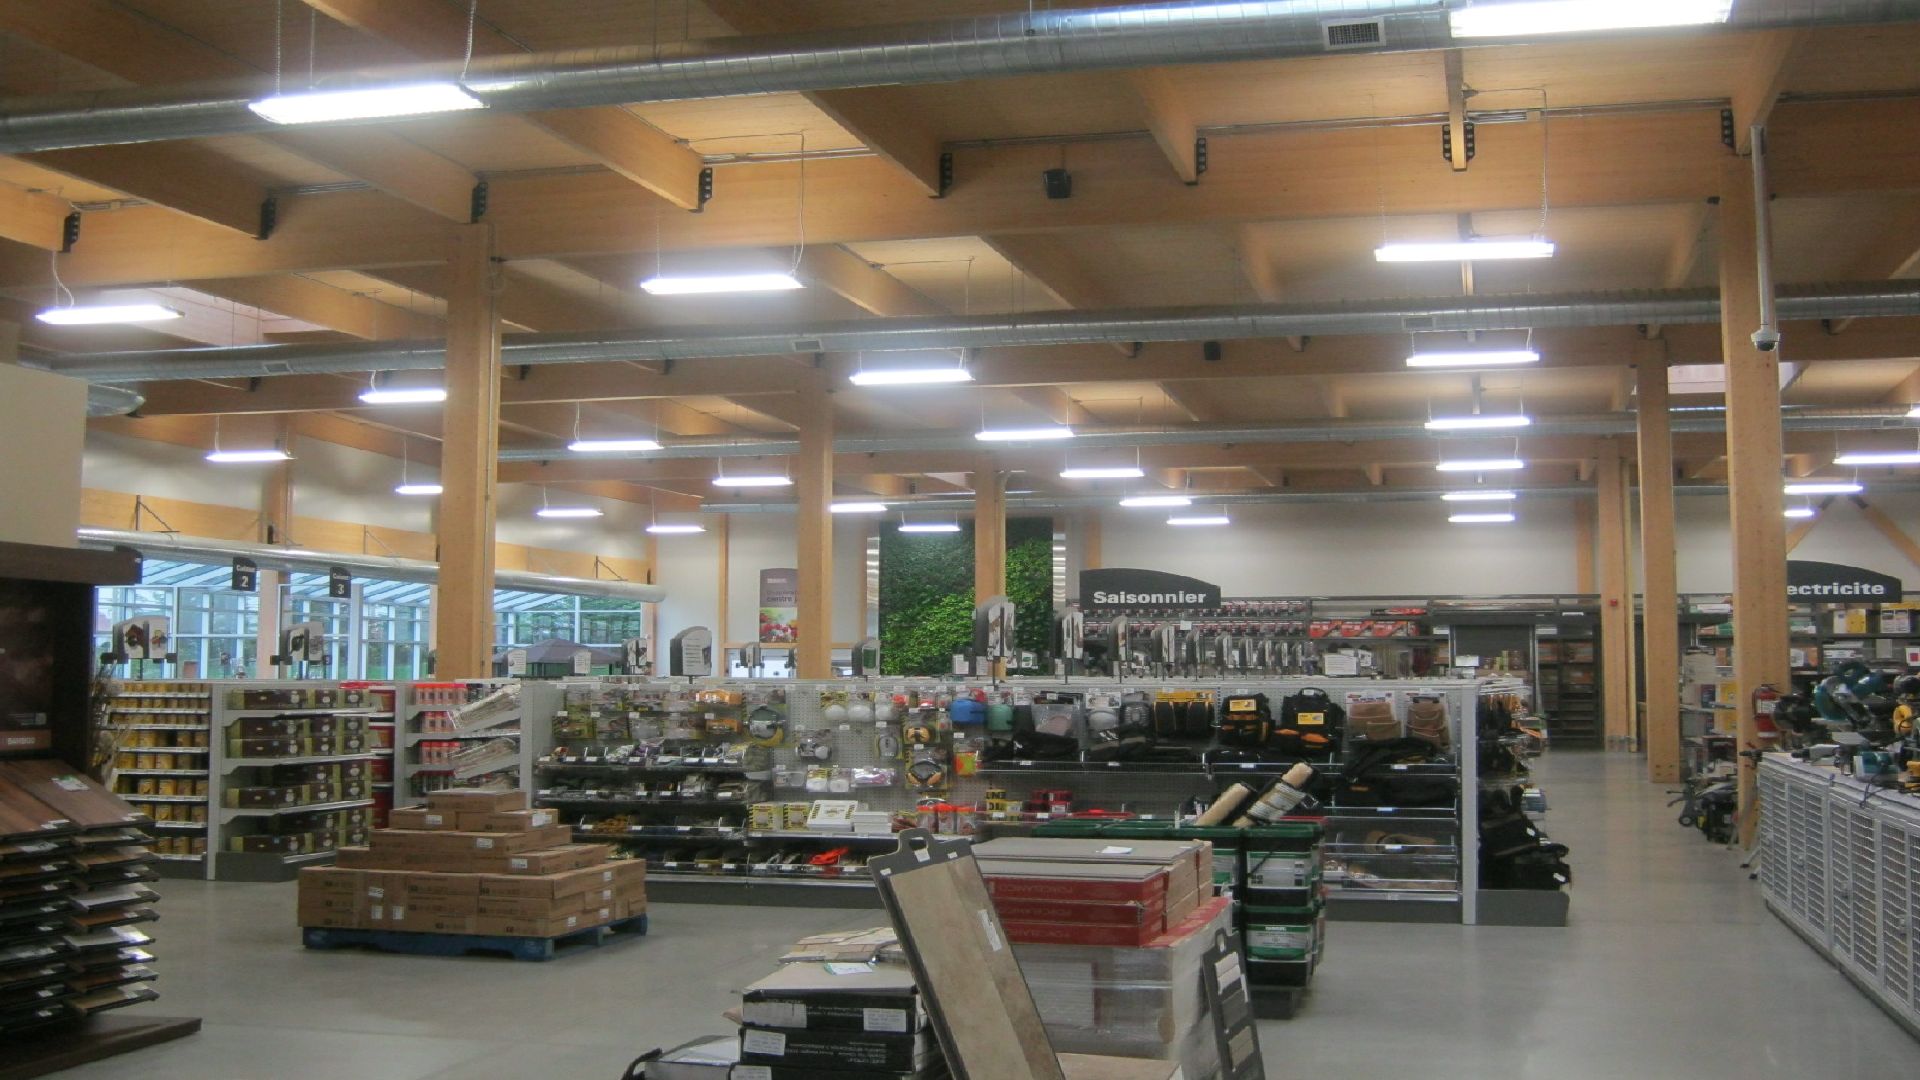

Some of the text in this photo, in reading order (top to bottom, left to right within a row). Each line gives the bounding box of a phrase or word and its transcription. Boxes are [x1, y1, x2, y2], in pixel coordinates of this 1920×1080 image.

[241, 576, 248, 588] 2
[337, 584, 344, 595] 3
[1094, 591, 1206, 604] Saisonnier
